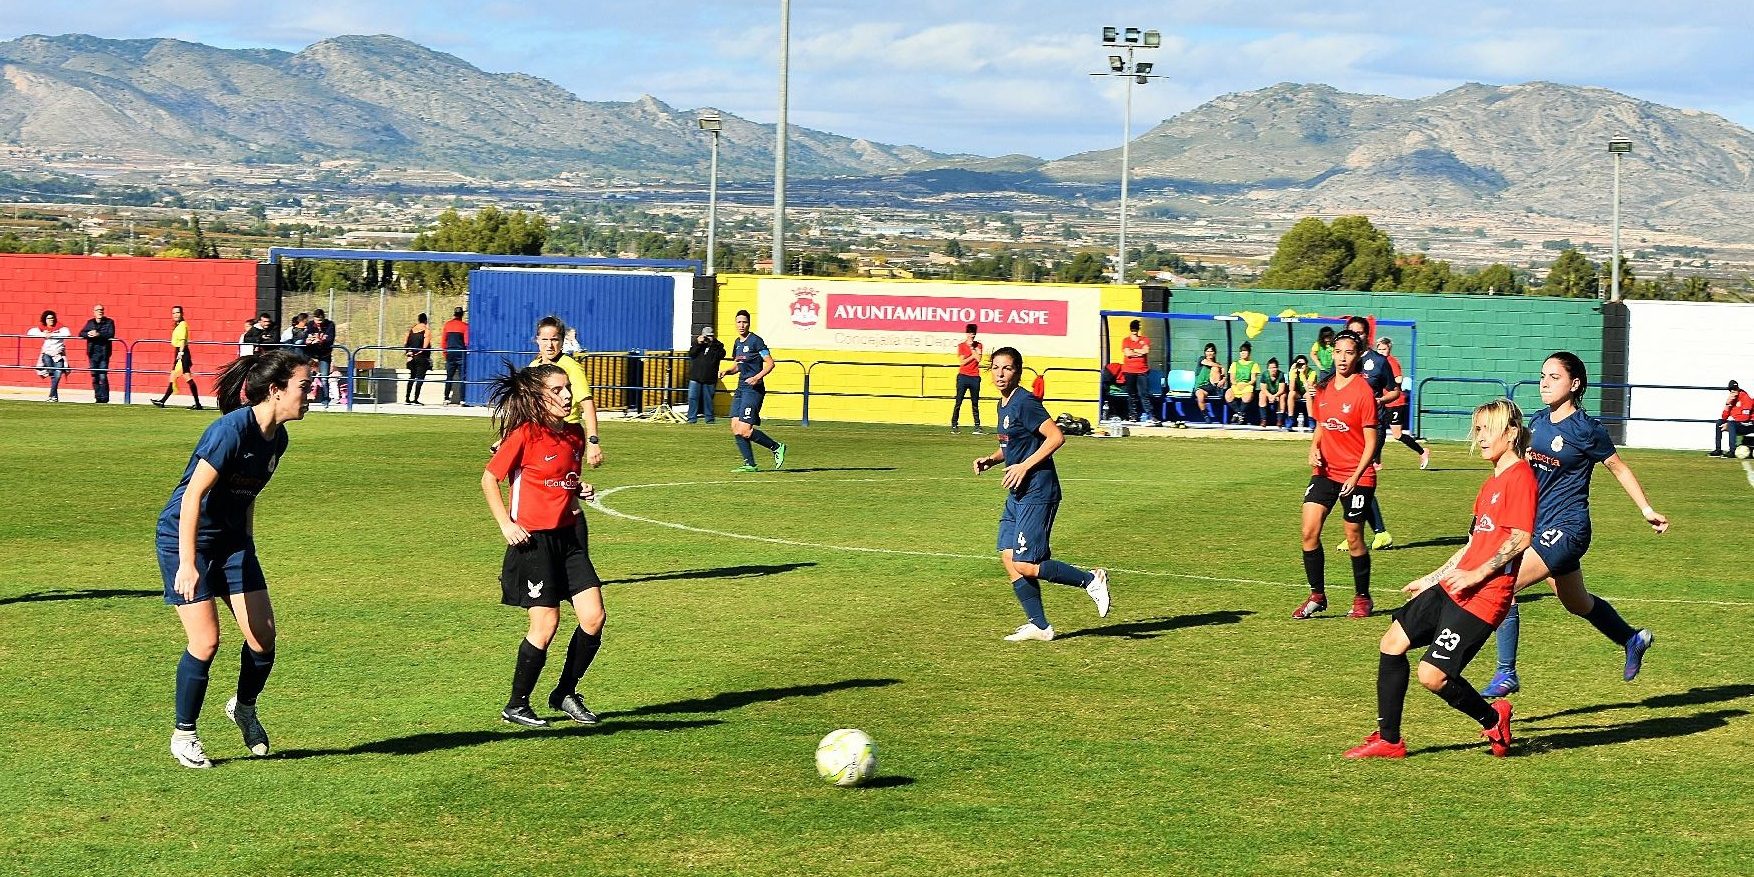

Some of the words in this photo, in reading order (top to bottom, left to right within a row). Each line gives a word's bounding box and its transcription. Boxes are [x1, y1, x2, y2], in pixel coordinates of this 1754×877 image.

[833, 304, 976, 323] AYUNTAMIENTO
[979, 308, 1004, 323] DE
[1006, 309, 1049, 325] ASPE
[904, 335, 920, 347] de
[924, 334, 960, 349] Depo
[1391, 411, 1399, 420] 7
[1350, 494, 1365, 509] 10
[1017, 531, 1027, 547] 4
[1539, 528, 1564, 548] 21
[1434, 627, 1462, 652] 23
